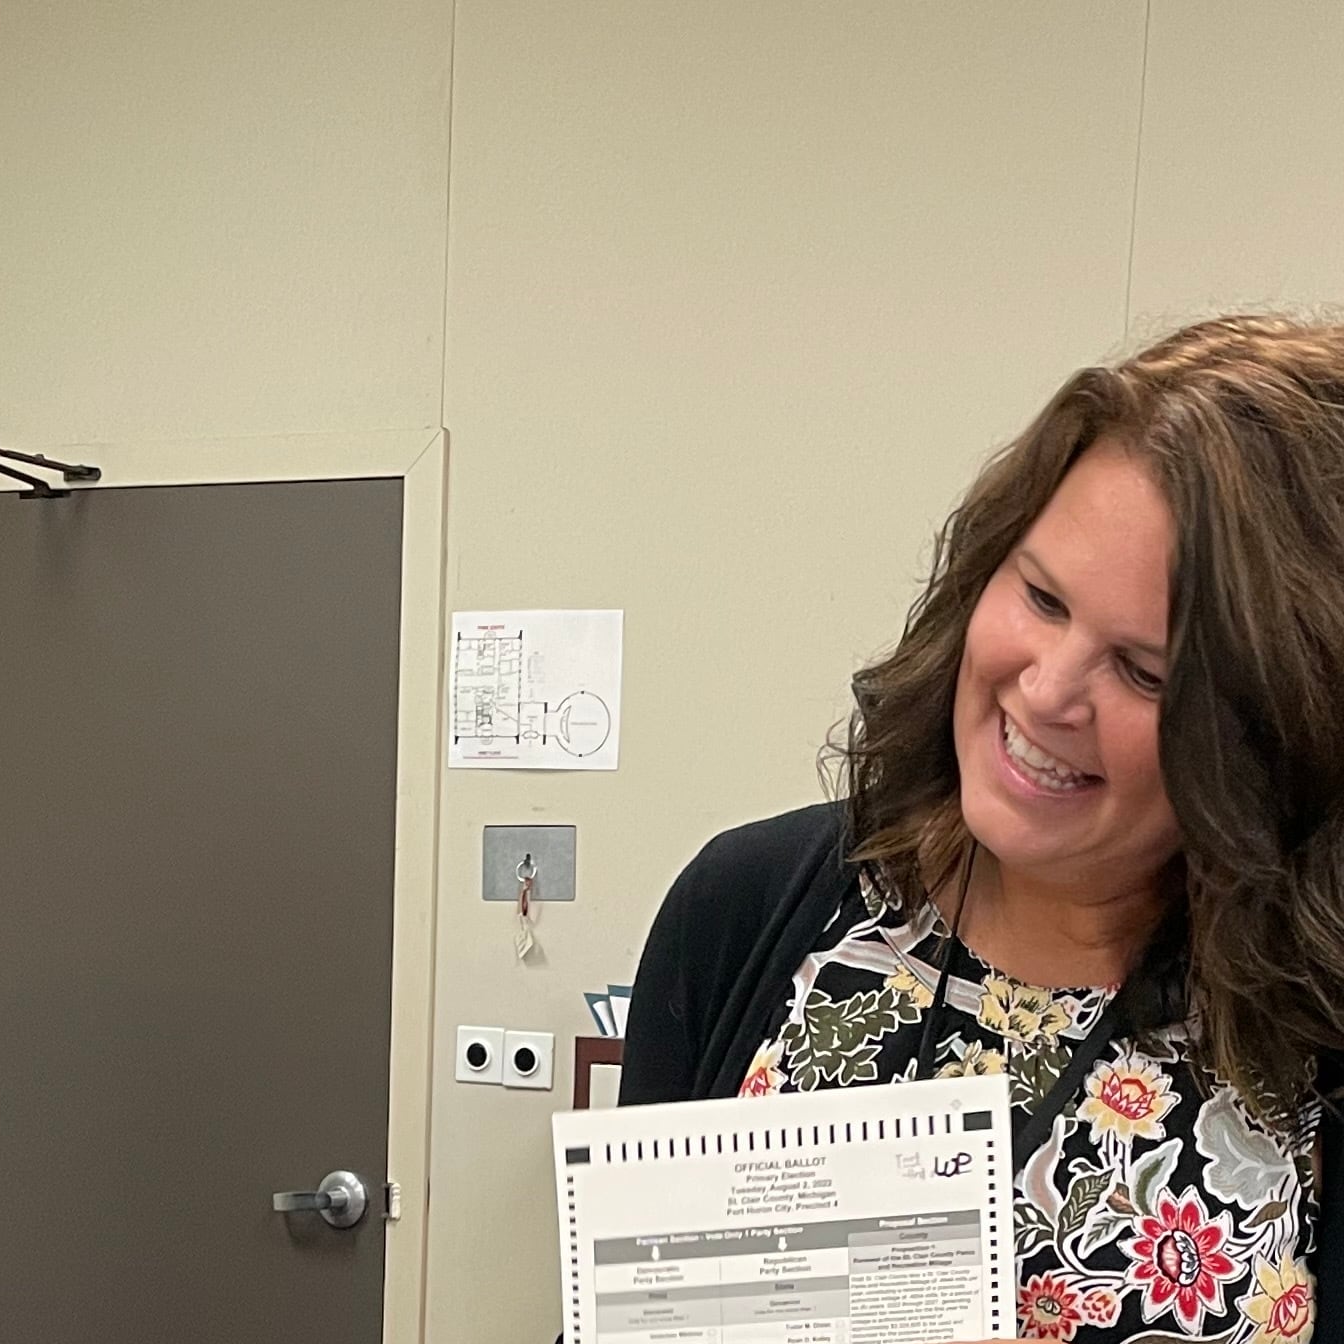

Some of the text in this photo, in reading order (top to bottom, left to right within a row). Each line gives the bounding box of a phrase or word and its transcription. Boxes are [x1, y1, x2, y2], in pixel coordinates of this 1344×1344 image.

[734, 1156, 827, 1174] OFFICIAL BALLOT
[746, 1170, 816, 1184] Primary Election
[770, 1181, 800, 1194] August
[797, 1190, 837, 1202] Michigan
[727, 1205, 744, 1216] Port
[746, 1204, 772, 1215] Huron
[795, 1201, 831, 1212] Precinct
[751, 1228, 772, 1239] Party
[773, 1226, 805, 1236] Section
[759, 1265, 781, 1276] Party
